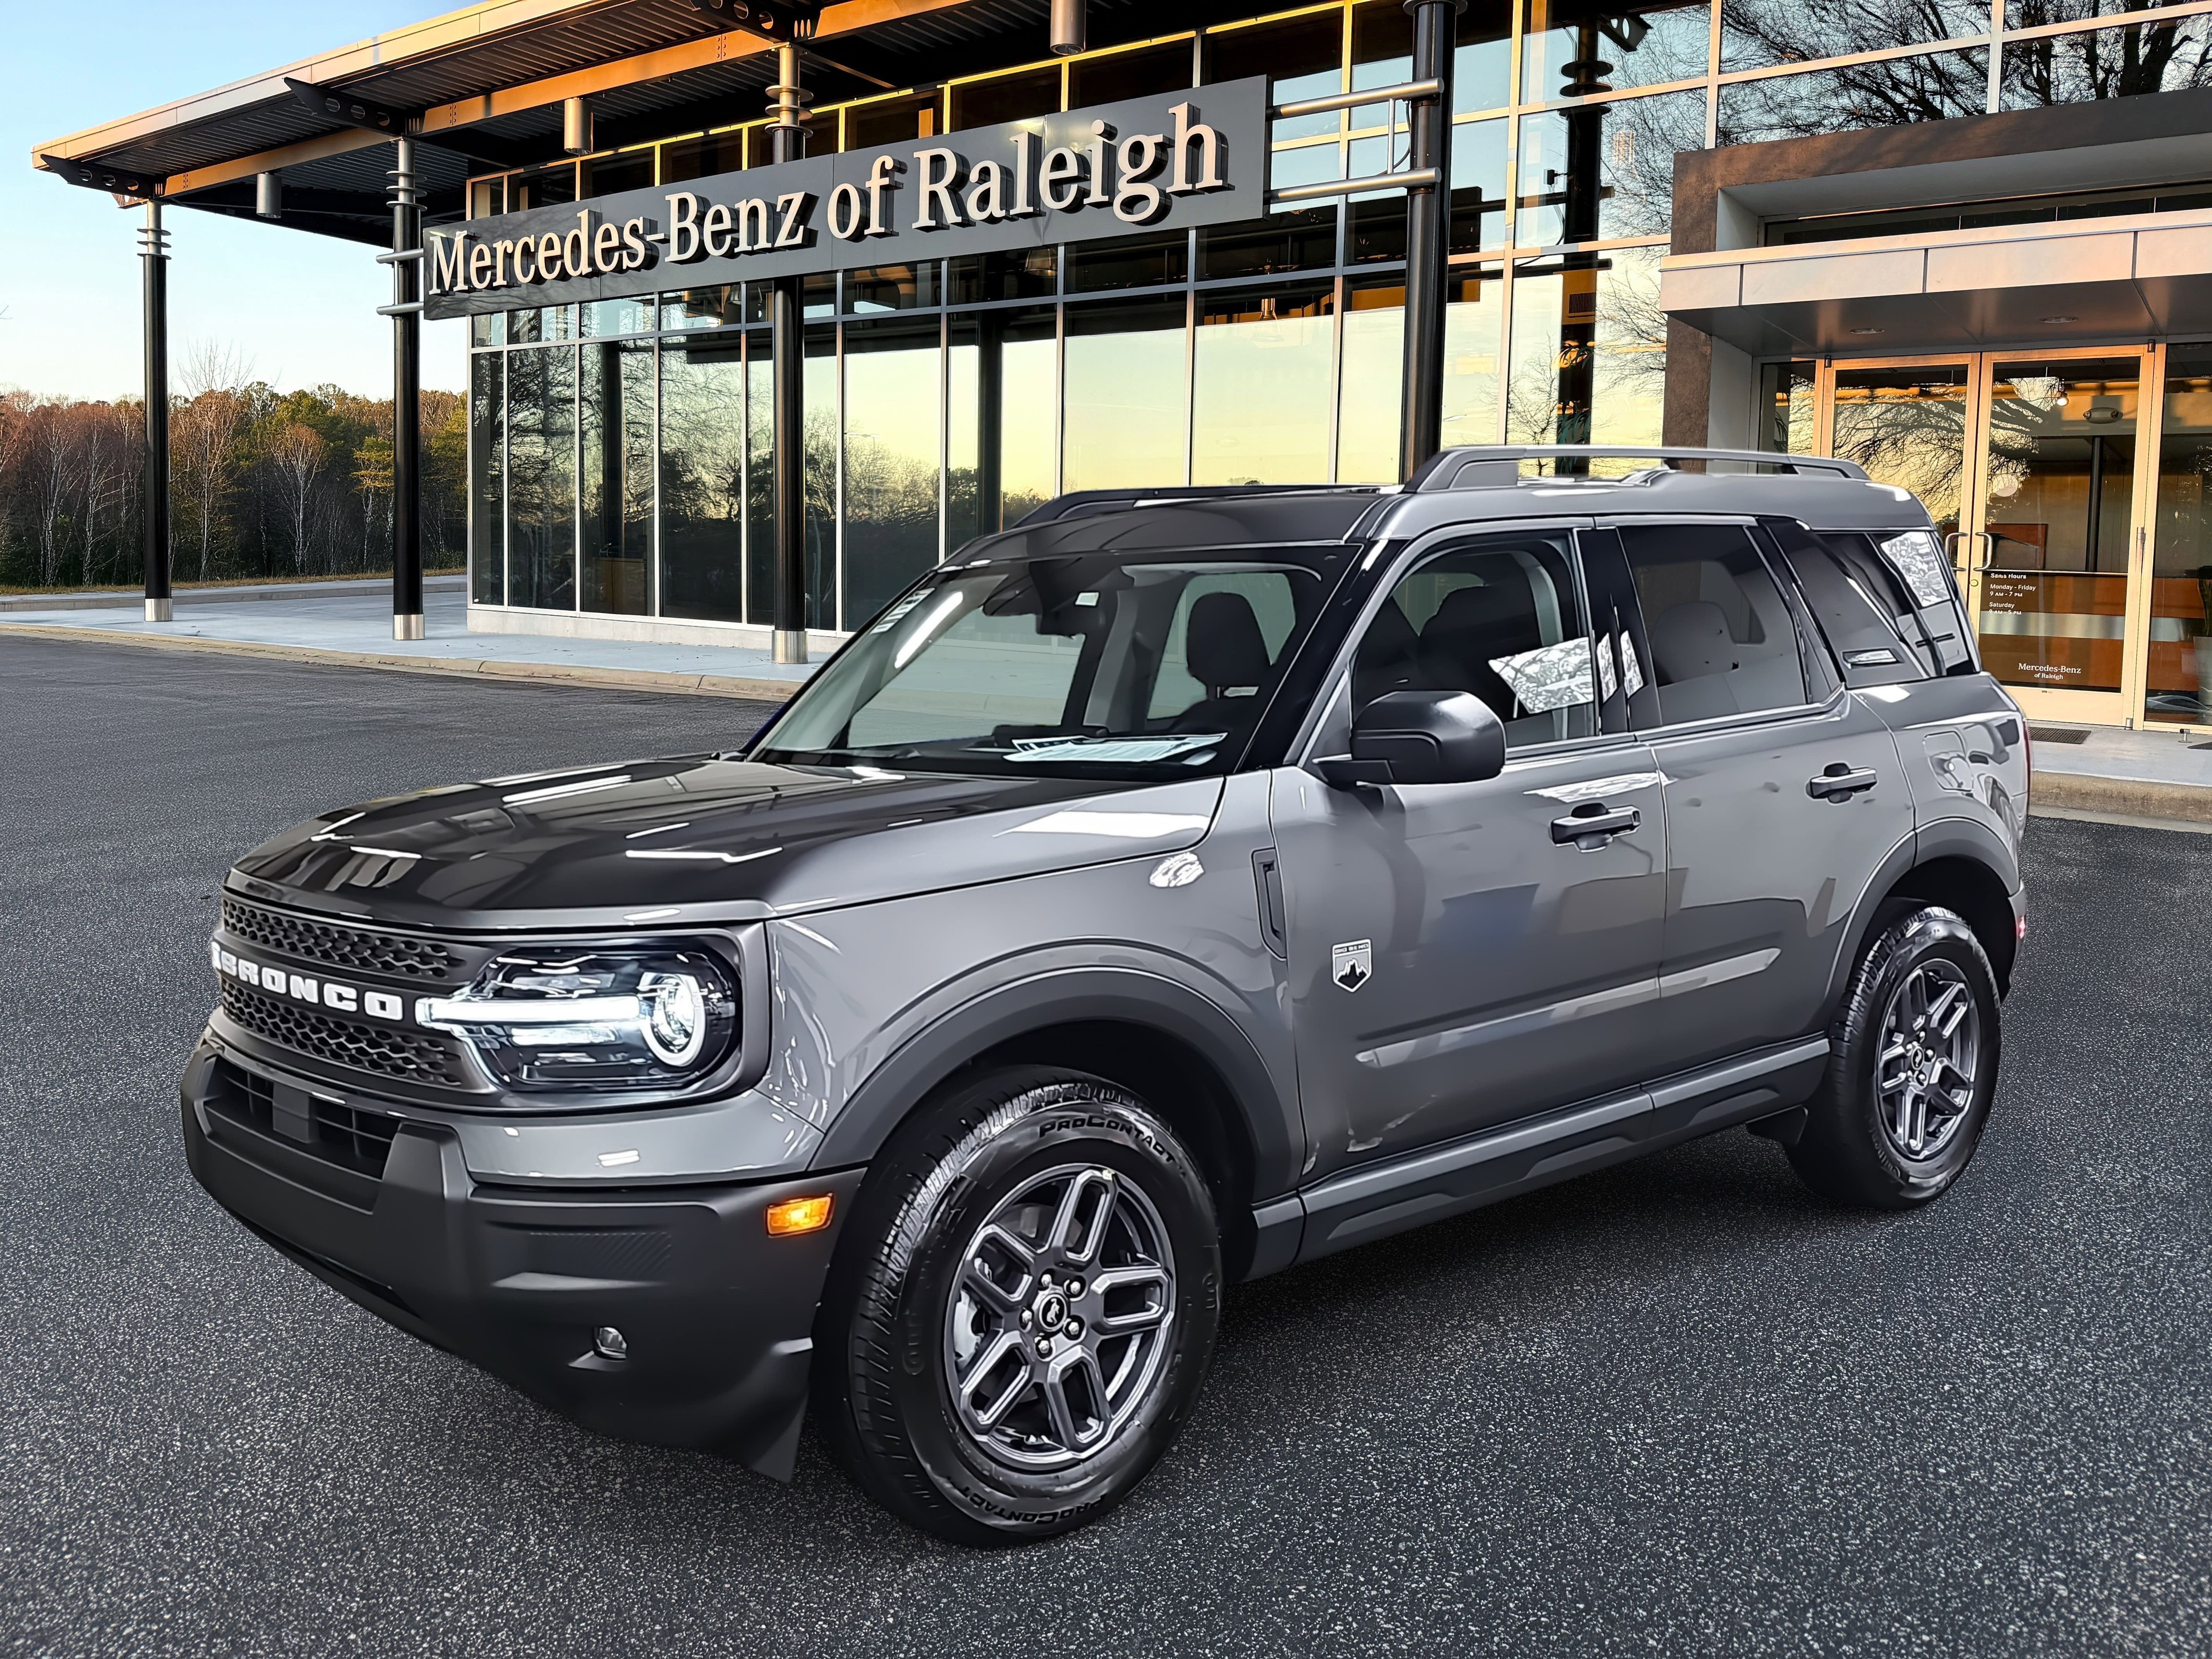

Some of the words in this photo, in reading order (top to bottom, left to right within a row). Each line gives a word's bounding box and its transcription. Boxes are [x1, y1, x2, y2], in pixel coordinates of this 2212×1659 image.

[428, 191, 809, 295] Mercedes-Benz
[827, 155, 895, 239] of
[912, 101, 1224, 230] Raleigh
[2018, 663, 2081, 674] Mercedes-Benz
[221, 950, 403, 1021] BRONCO
